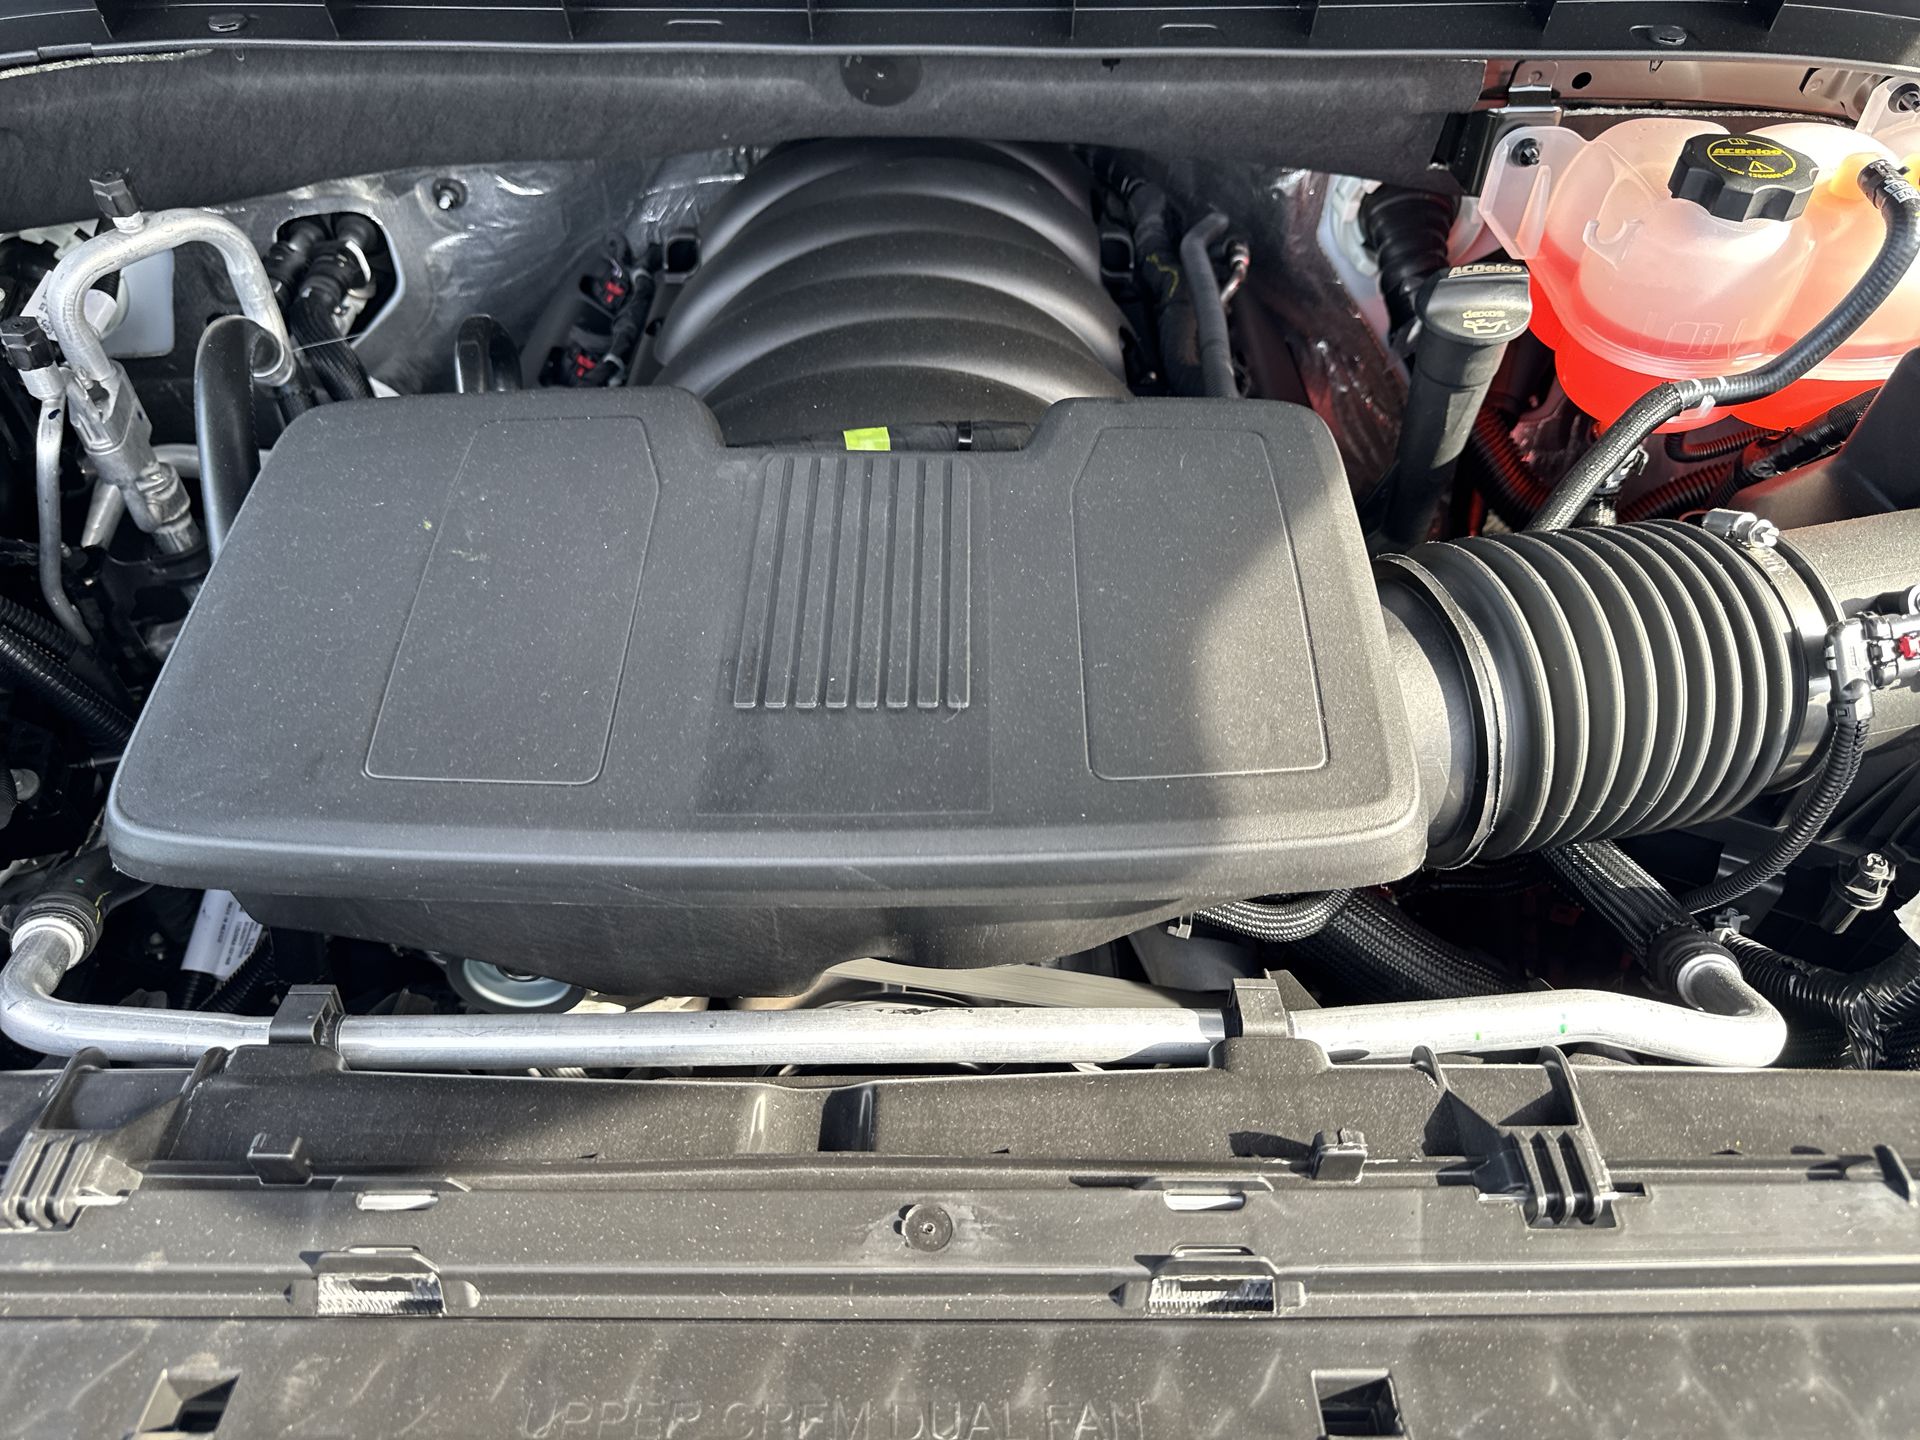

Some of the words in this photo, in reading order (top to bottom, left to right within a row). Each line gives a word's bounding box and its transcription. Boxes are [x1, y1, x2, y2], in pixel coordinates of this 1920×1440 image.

[1712, 147, 1783, 156] ACDelco
[1448, 264, 1523, 277] ACDelco
[517, 1401, 700, 1439] UPPER
[891, 1400, 1029, 1439] DUAL
[1044, 1400, 1144, 1439] FAN
